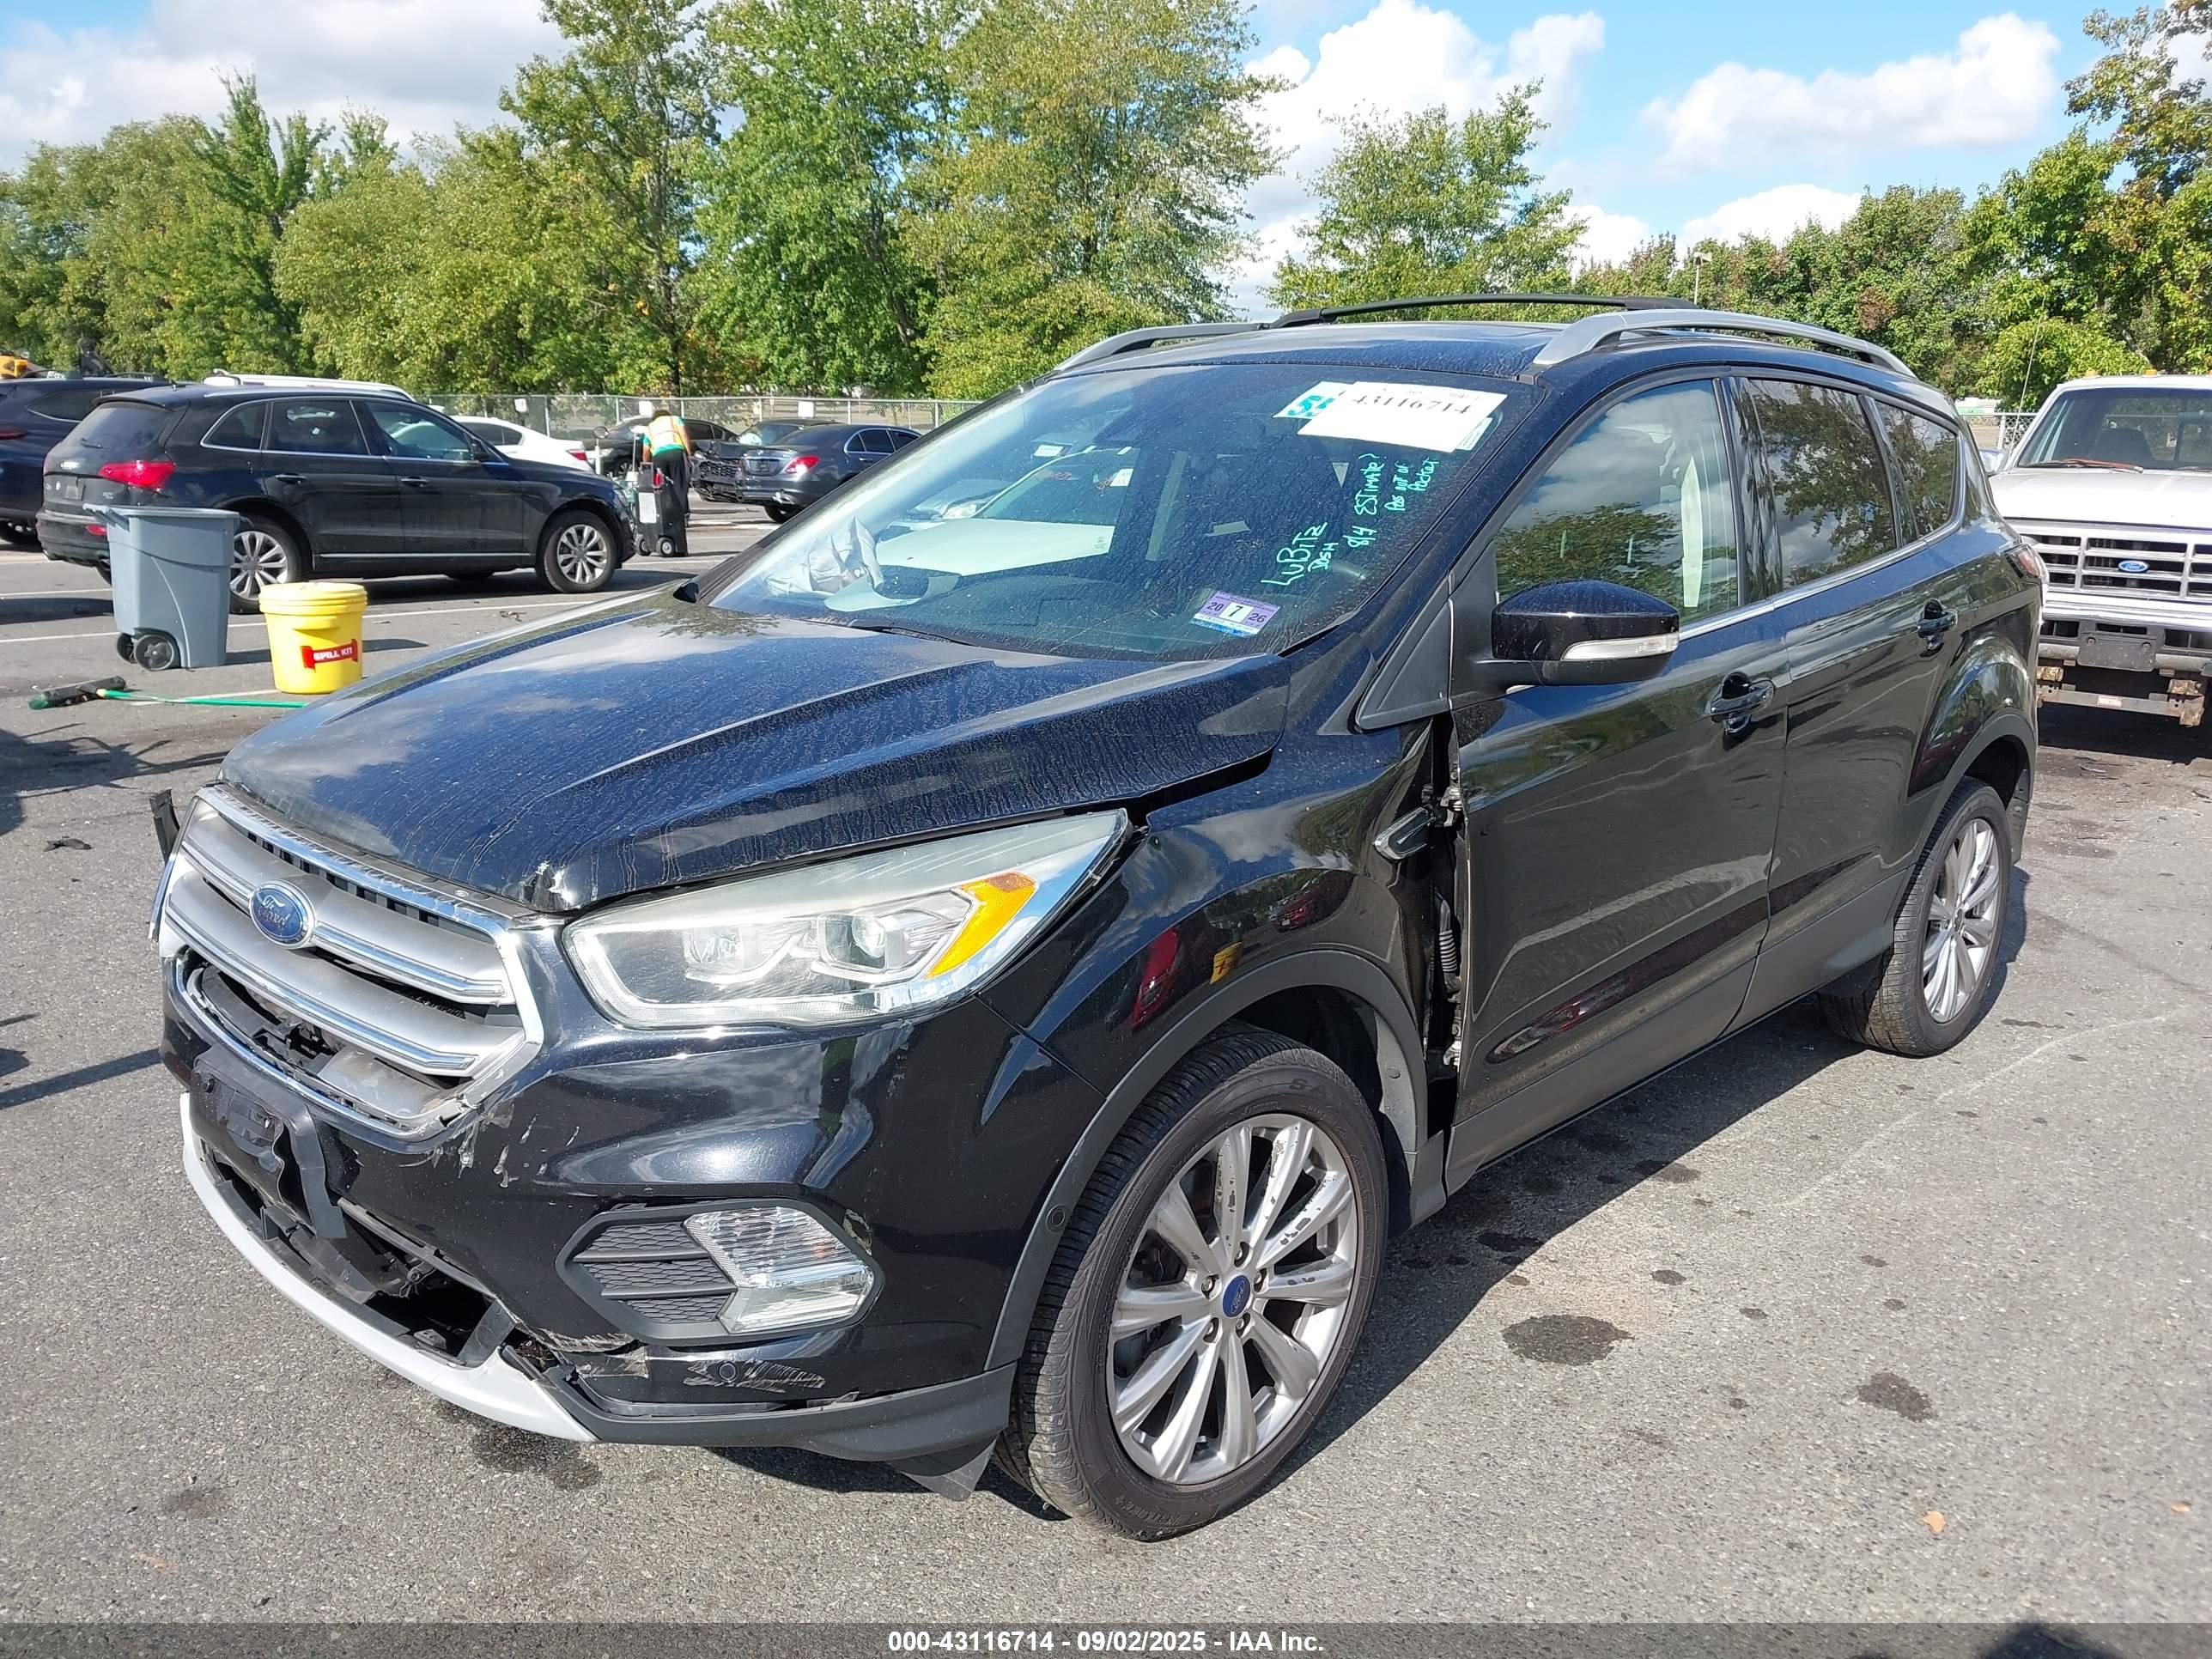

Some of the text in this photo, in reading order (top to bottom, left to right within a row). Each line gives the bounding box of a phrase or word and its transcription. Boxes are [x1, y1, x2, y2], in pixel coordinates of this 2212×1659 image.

[1352, 394, 1472, 415] 43116714
[1206, 602, 1267, 623] 20 7 26
[313, 647, 353, 661] SPILL KIT
[258, 894, 292, 928] Ford
